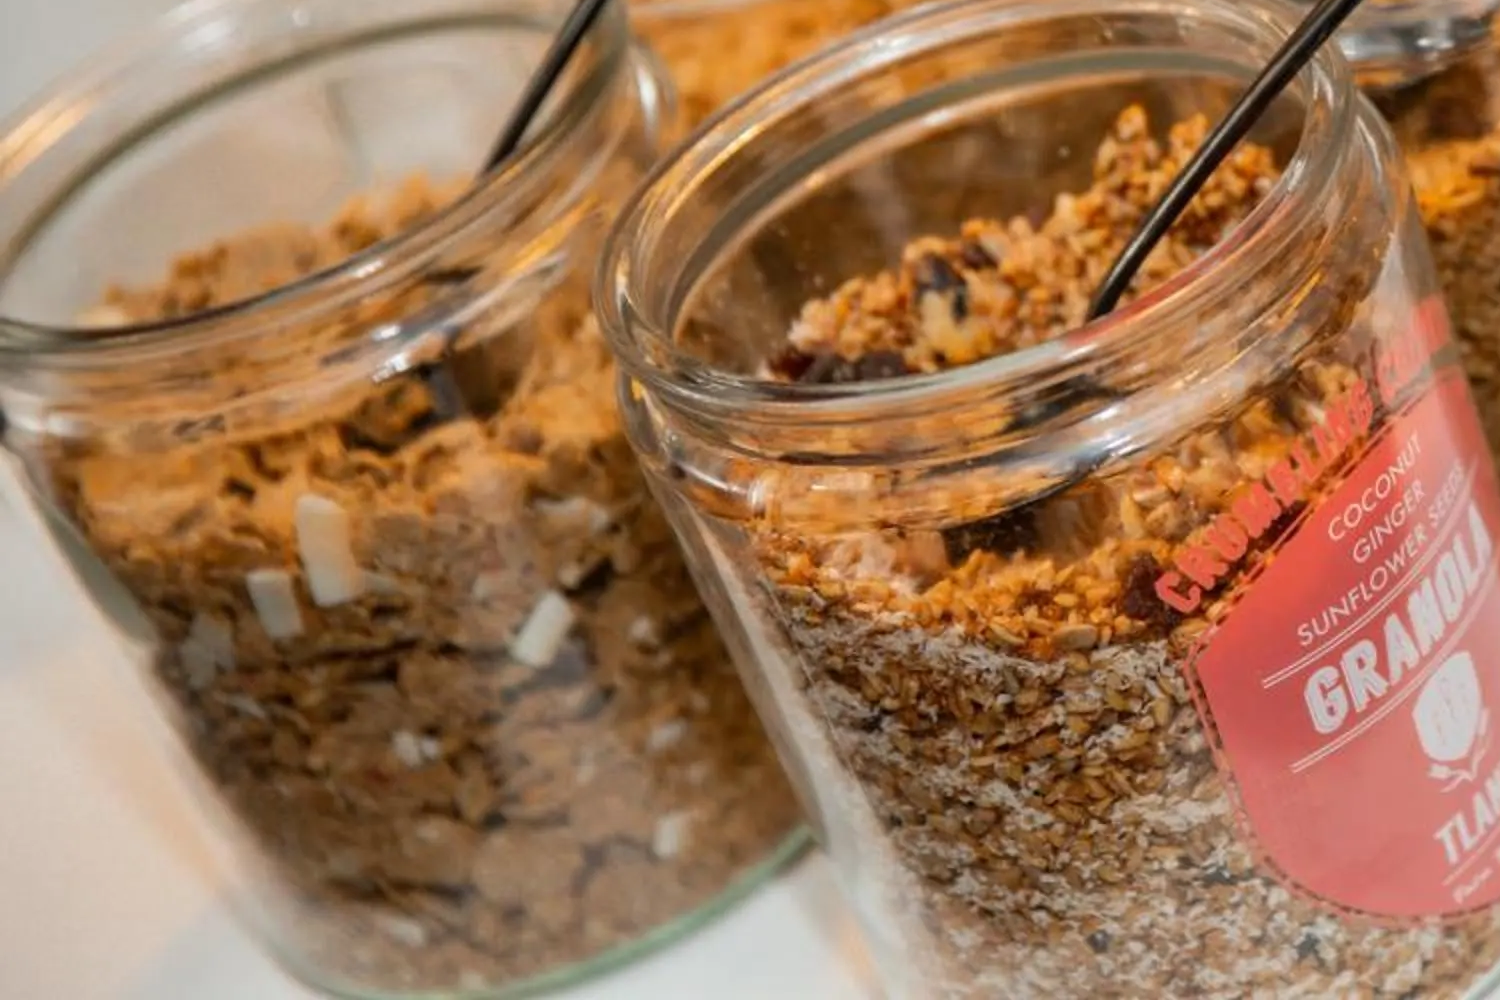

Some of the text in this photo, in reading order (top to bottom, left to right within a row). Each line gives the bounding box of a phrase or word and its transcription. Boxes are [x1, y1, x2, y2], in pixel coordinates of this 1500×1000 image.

[1155, 380, 1375, 614] CRUMBLING
[1327, 430, 1422, 542] COCONUT
[1352, 479, 1426, 564] GINGER
[1297, 522, 1429, 647] SUNFLOWER
[1303, 500, 1493, 735] GRANOLA
